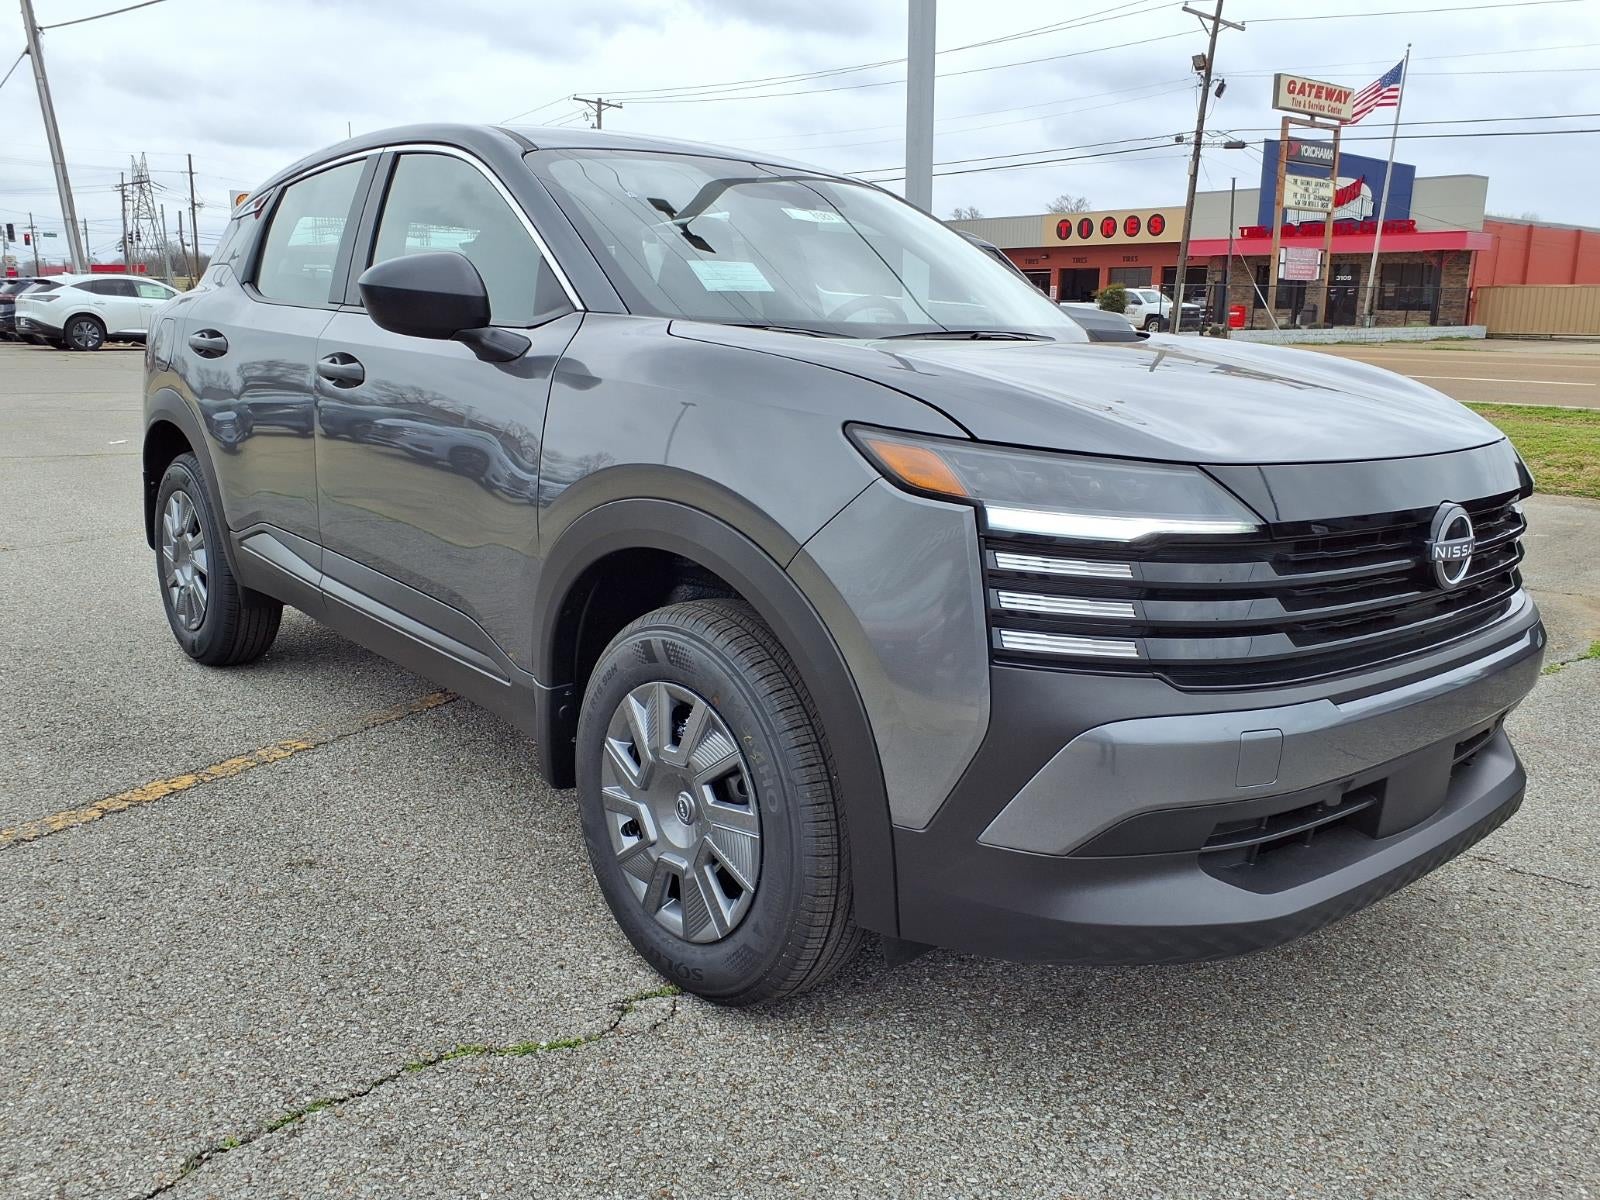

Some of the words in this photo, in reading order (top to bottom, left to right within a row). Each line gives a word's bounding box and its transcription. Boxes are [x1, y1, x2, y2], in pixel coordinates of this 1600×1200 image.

[1286, 79, 1352, 105] GATEWAY
[1300, 144, 1334, 160] YOKOHAMA
[1058, 215, 1163, 239] TIRES
[1434, 543, 1473, 559] NISSA
